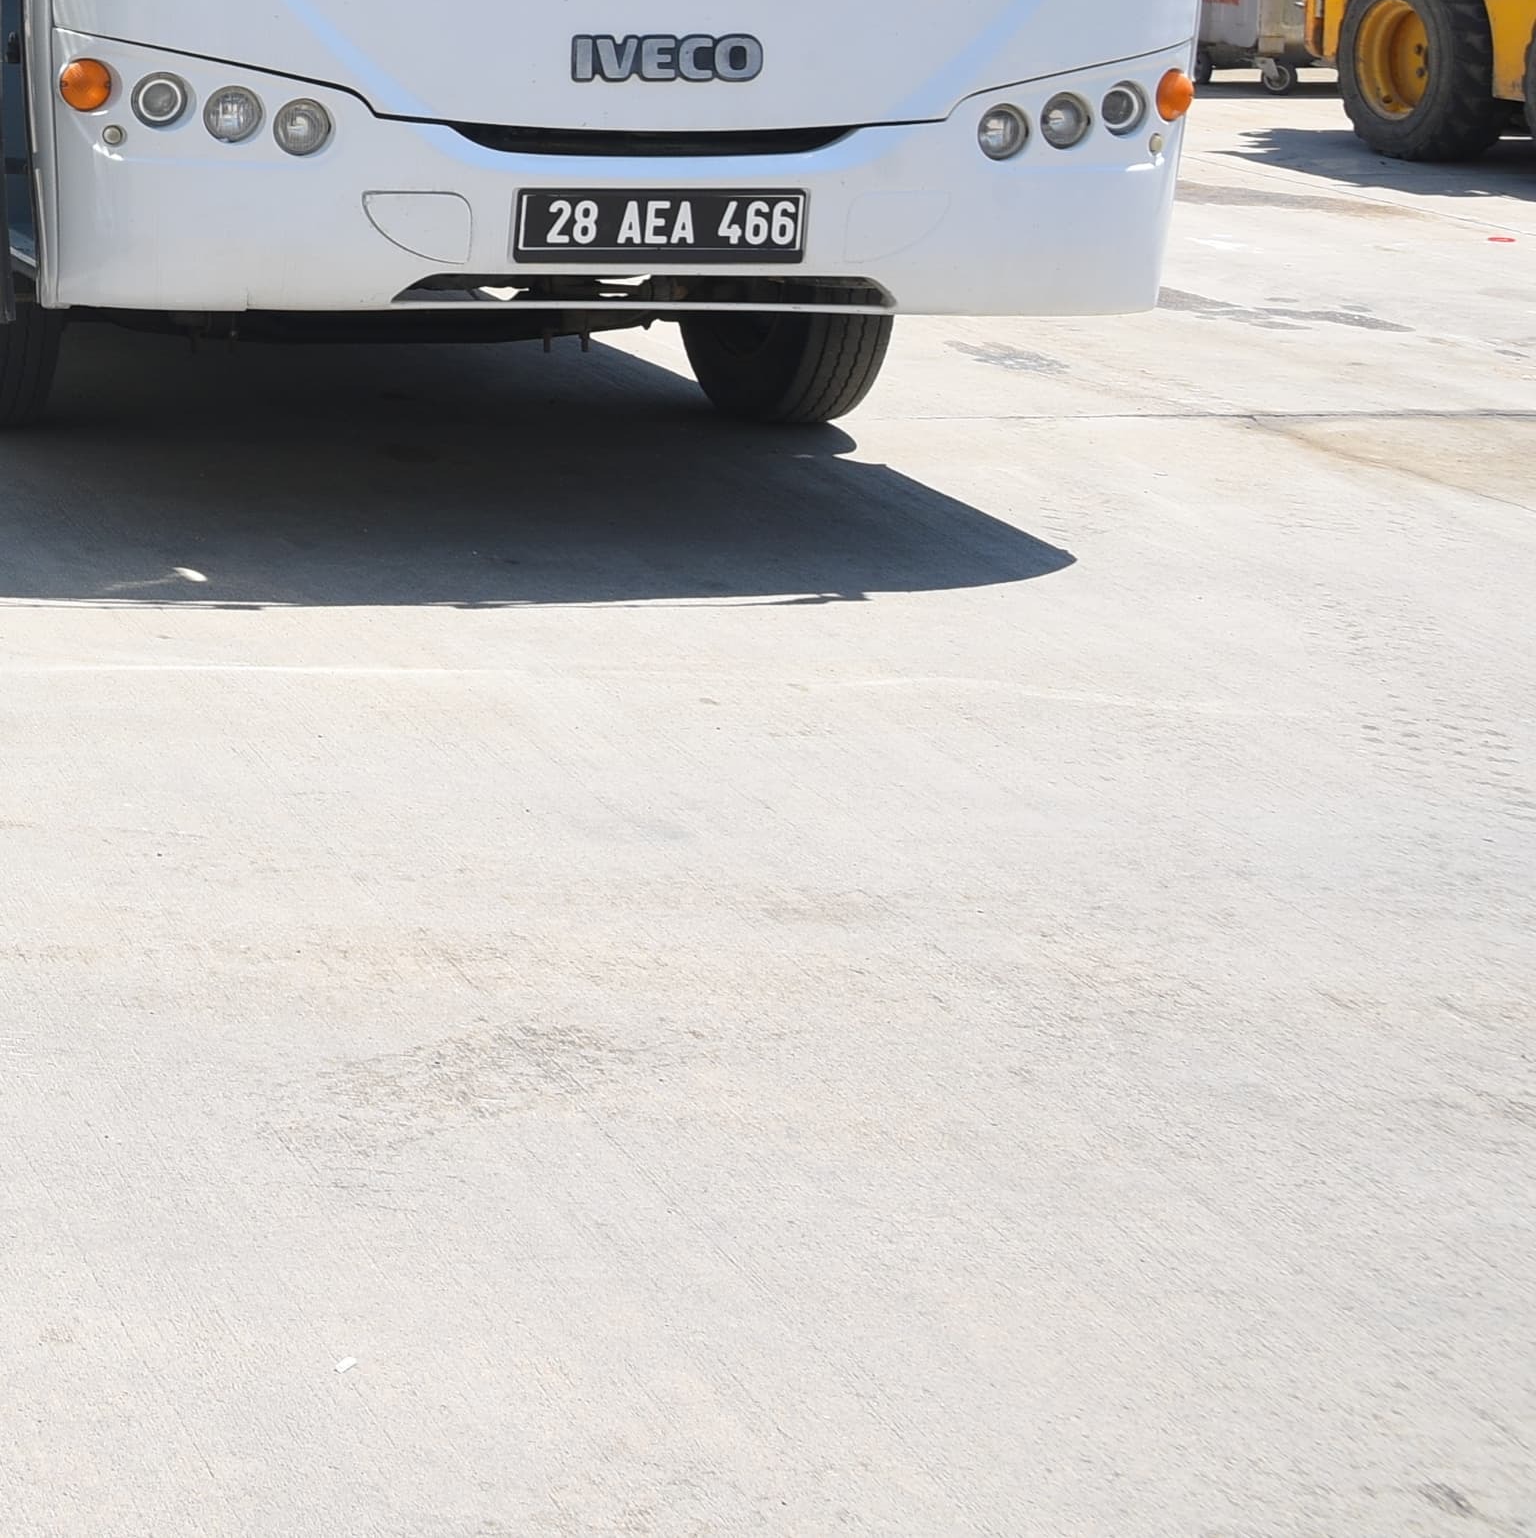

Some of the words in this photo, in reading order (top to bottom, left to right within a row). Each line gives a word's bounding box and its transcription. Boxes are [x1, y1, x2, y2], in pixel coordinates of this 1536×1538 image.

[571, 33, 764, 83] IVECO
[546, 200, 599, 245] 28
[616, 200, 695, 245] AEA
[717, 200, 797, 245] 466
